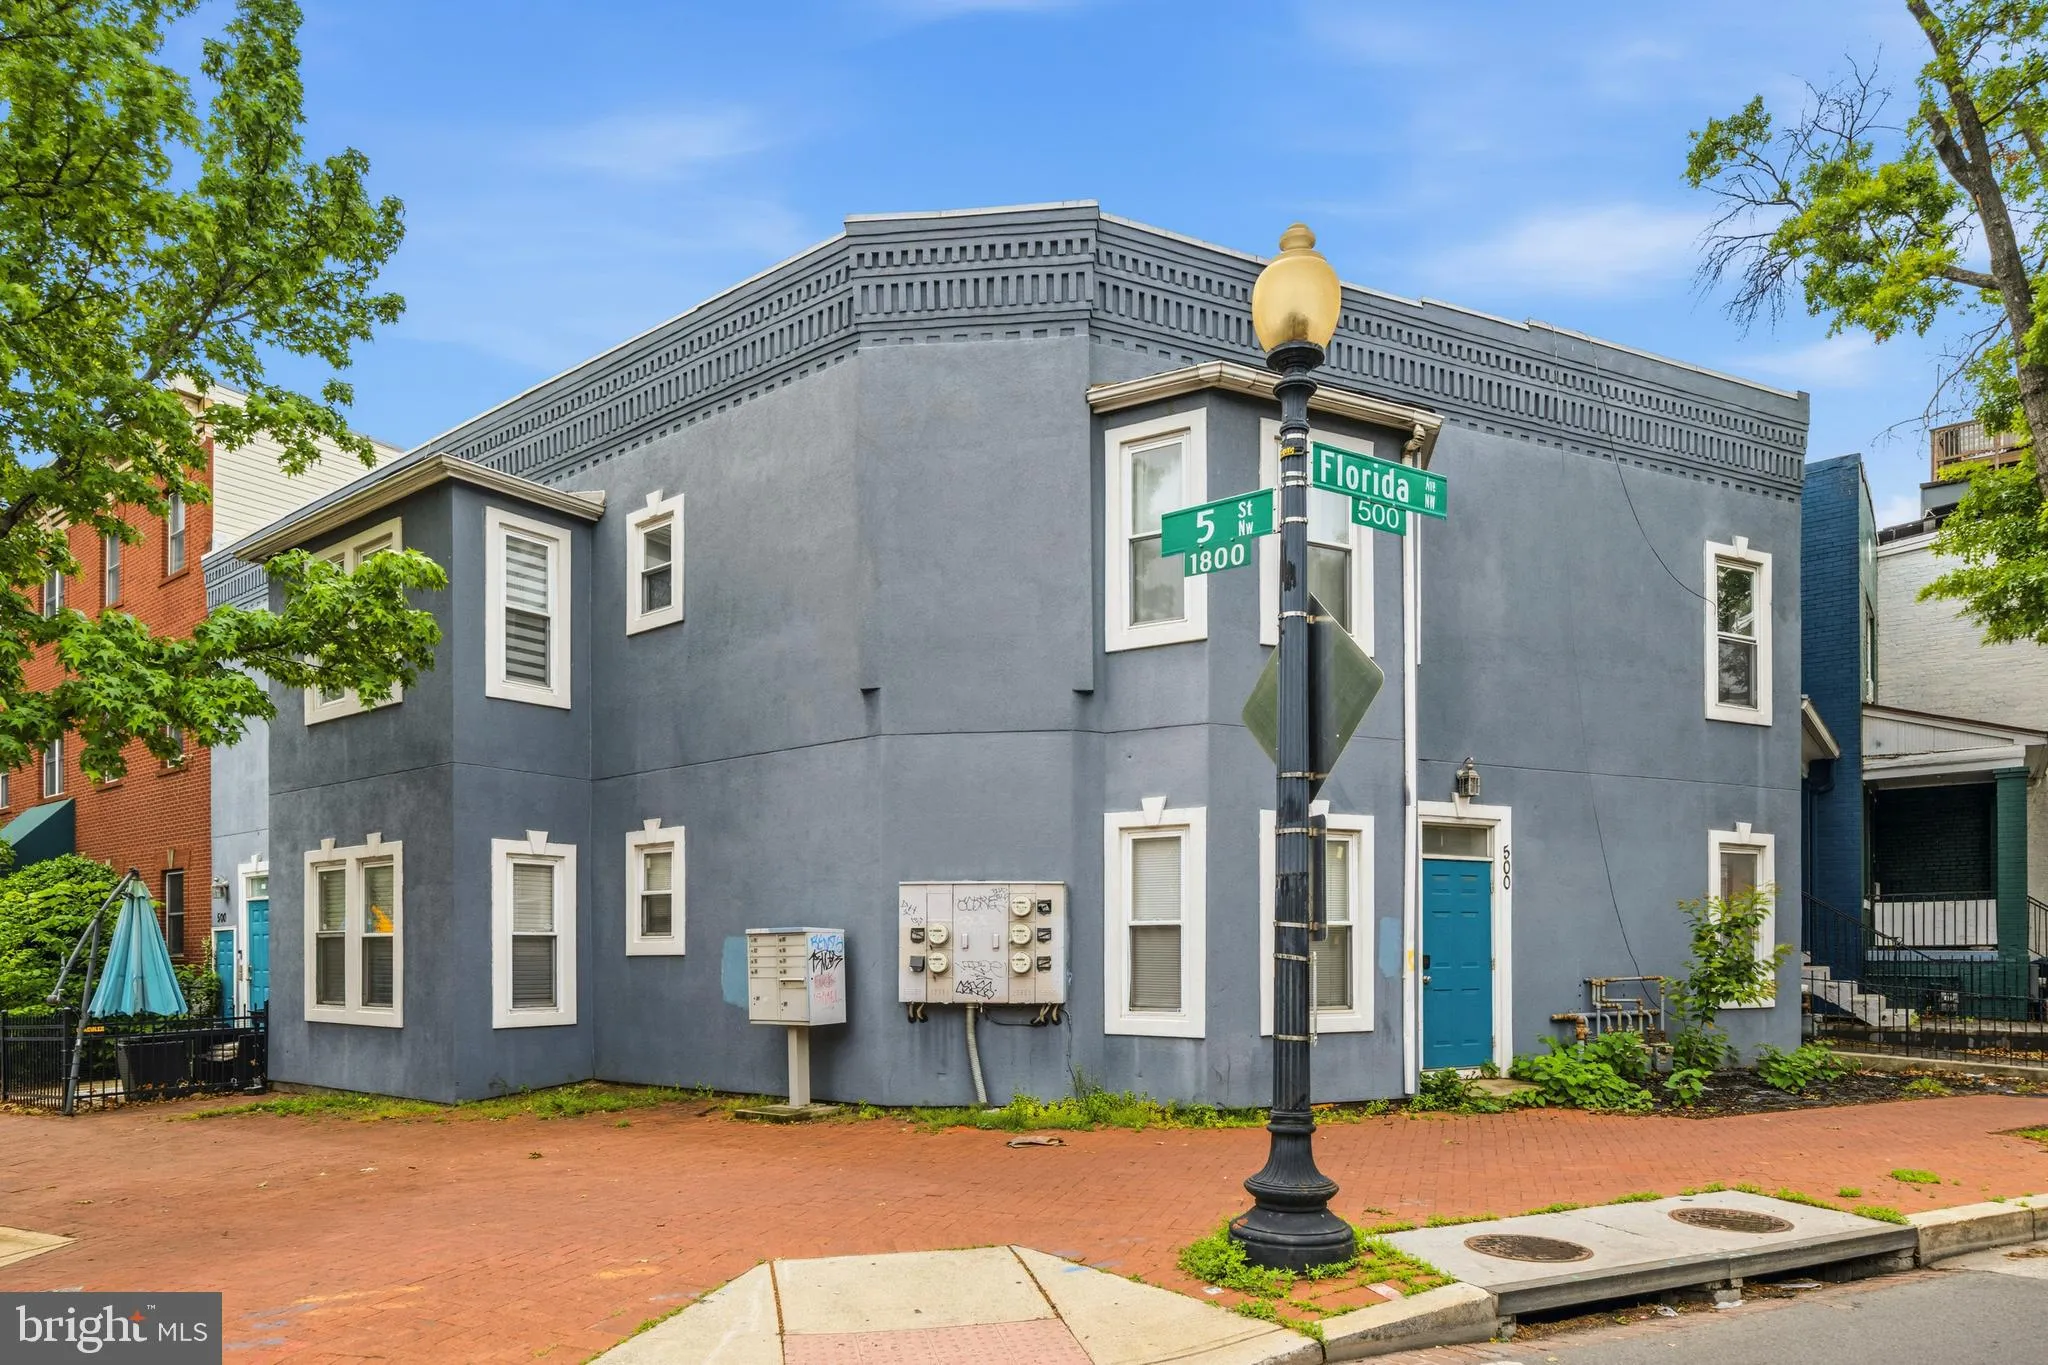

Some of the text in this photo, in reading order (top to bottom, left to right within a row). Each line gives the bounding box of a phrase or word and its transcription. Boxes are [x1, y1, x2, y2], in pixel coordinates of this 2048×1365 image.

[1320, 450, 1409, 503] Florida
[1425, 476, 1436, 493] Ave
[1237, 500, 1253, 519] St
[1358, 500, 1399, 529] 500
[1424, 493, 1436, 510] NW
[1196, 508, 1215, 544] 5
[1190, 543, 1245, 575] 1800
[1503, 844, 1511, 890] 500
